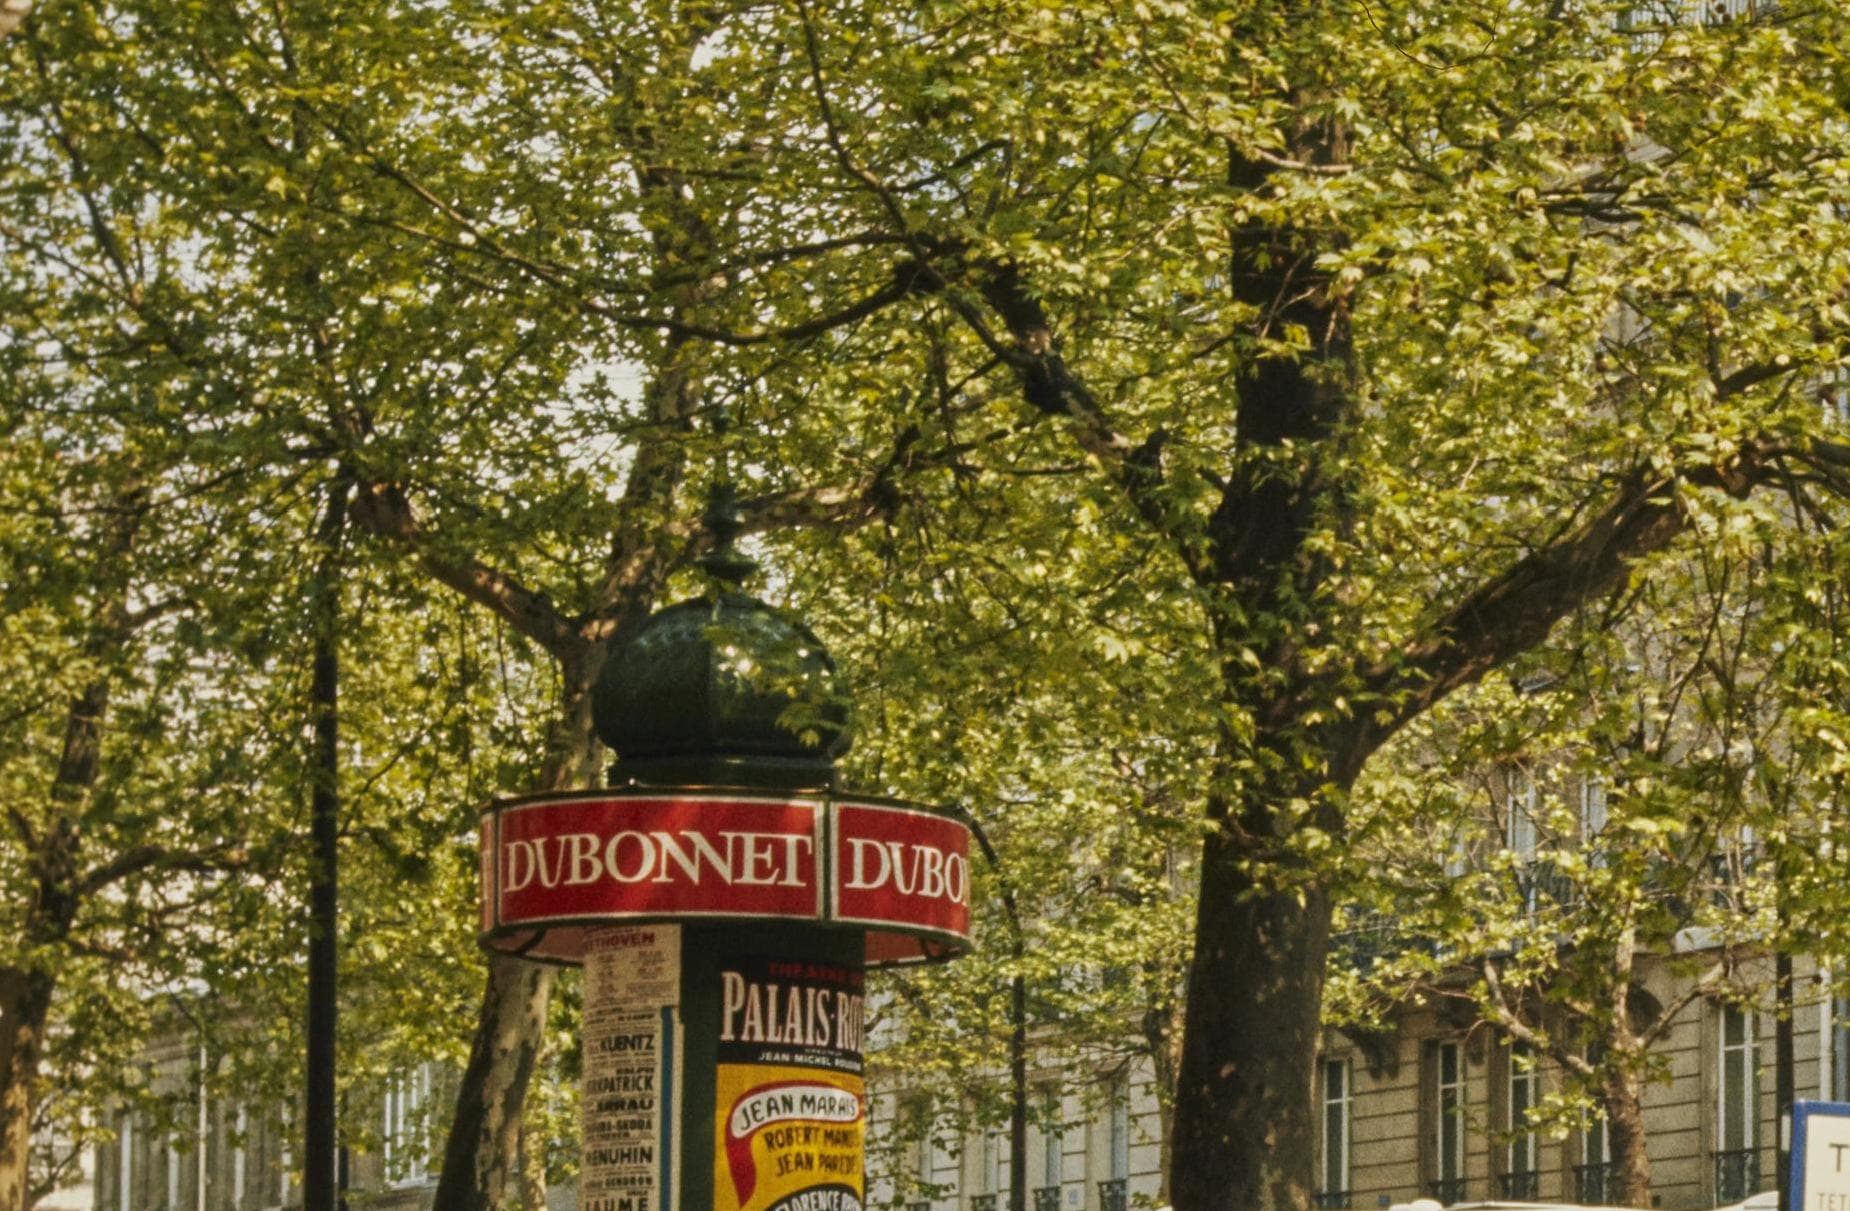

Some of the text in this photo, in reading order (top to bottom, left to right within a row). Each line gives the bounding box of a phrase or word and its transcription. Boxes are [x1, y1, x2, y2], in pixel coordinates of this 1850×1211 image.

[504, 830, 812, 893] DUBONNET
[740, 1095, 794, 1131] JEAN
[764, 1126, 819, 1152] ROBERT
[776, 1152, 813, 1178] JEAN
